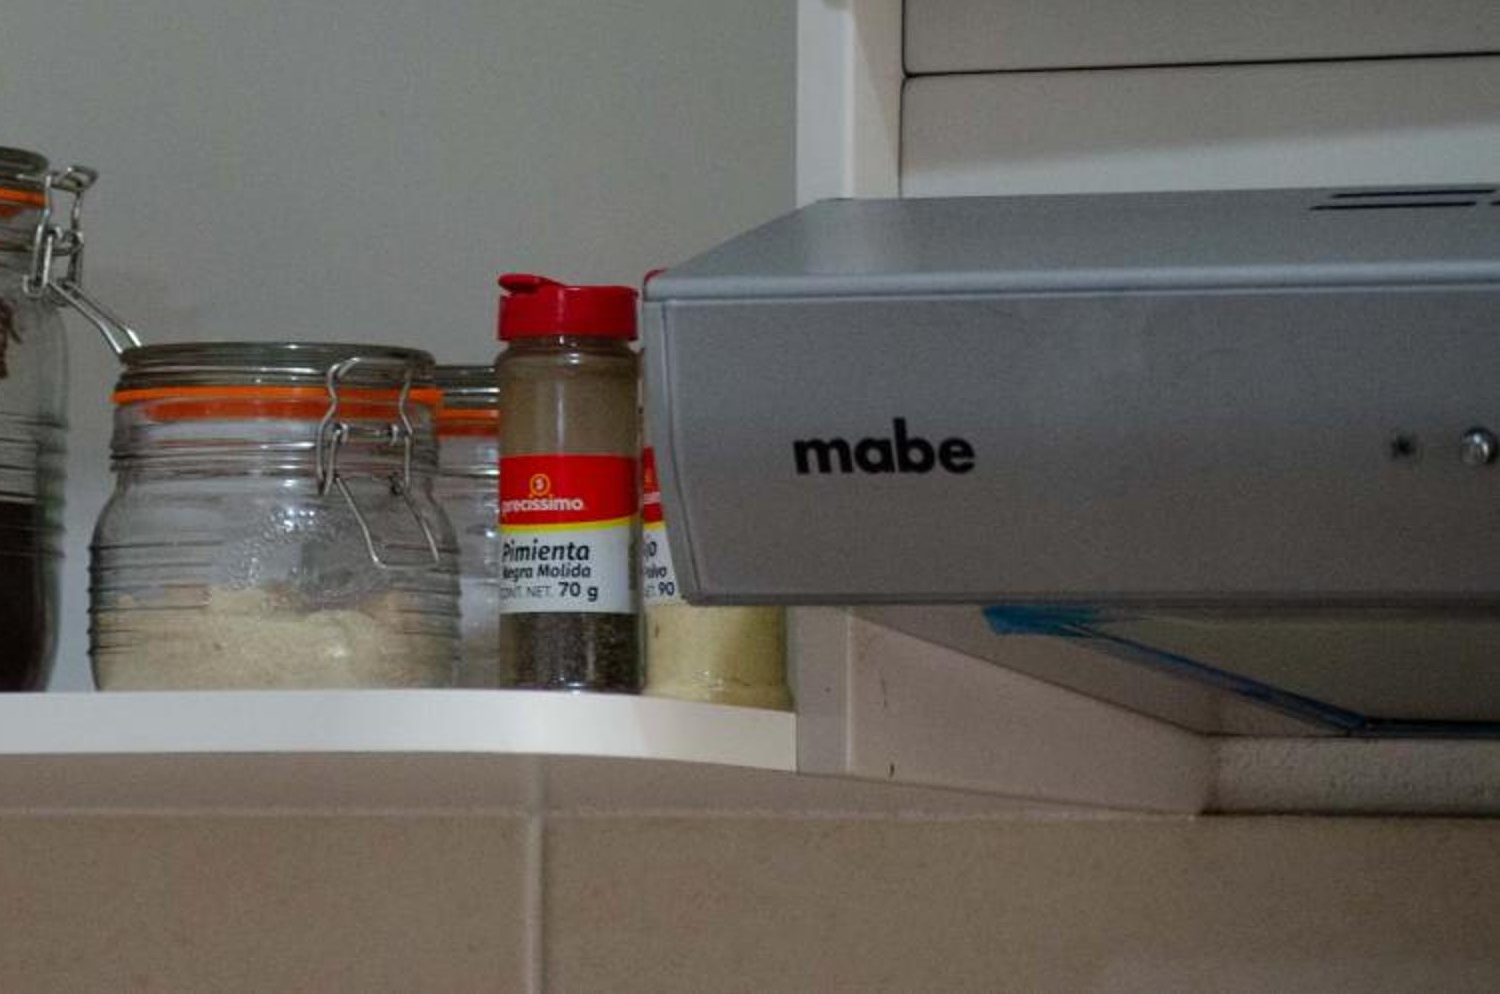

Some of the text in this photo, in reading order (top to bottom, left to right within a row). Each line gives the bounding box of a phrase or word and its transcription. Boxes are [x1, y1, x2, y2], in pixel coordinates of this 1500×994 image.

[793, 417, 976, 474] mabe
[502, 538, 590, 563] Pimienta
[536, 563, 592, 578] Molida
[557, 581, 581, 598] 70
[586, 586, 599, 603] g
[657, 581, 676, 598] 90
